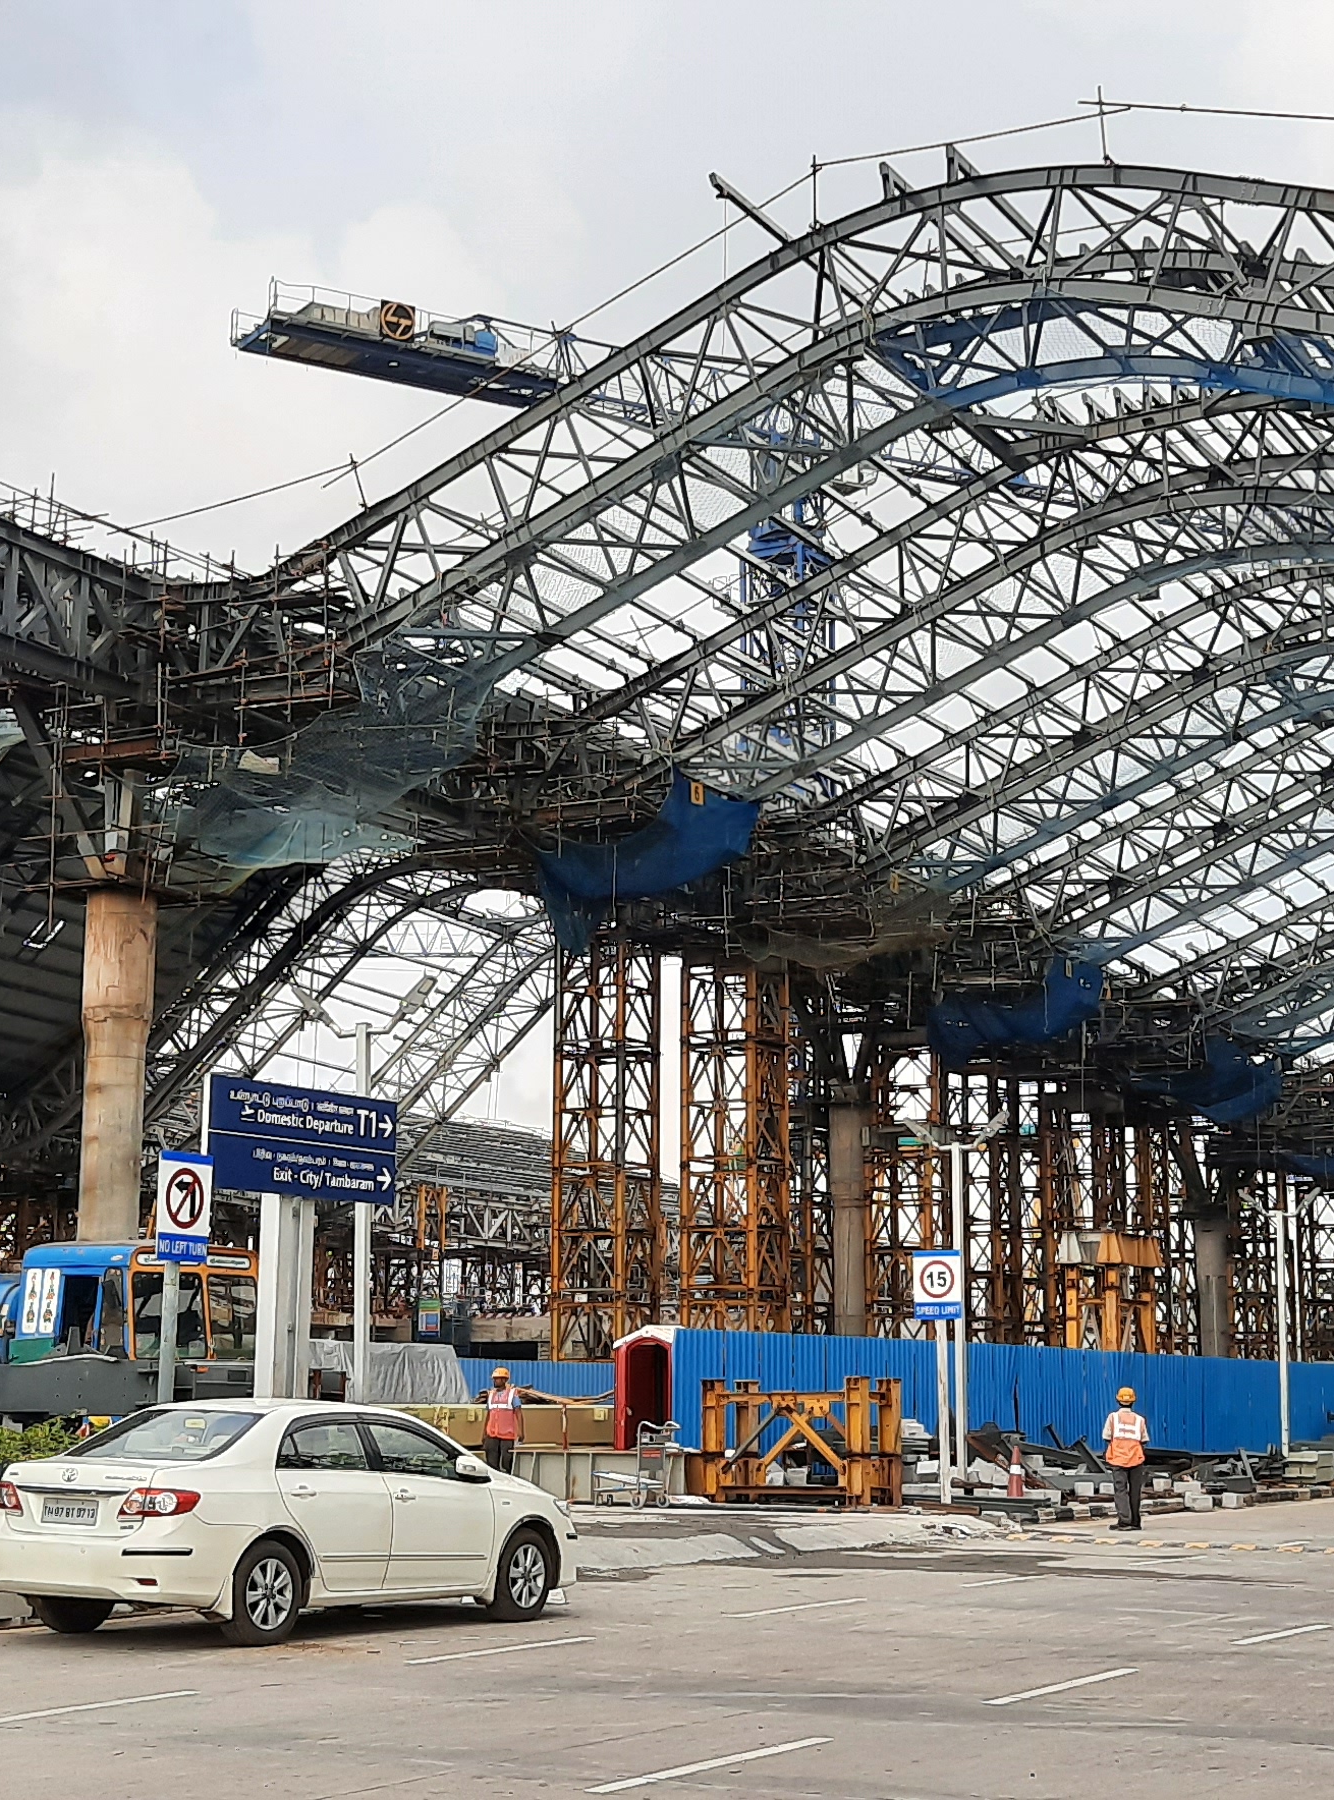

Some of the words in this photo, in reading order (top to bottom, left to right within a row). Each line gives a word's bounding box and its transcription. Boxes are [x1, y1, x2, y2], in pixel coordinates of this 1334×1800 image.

[257, 1109, 304, 1128] Domestic
[306, 1116, 354, 1135] Departure
[357, 1109, 377, 1138] T1
[273, 1167, 293, 1183] Exit
[325, 1173, 375, 1191] Tambaram
[159, 1239, 170, 1253] NO
[171, 1241, 187, 1255] LEFT
[188, 1243, 207, 1257] TURN
[927, 1271, 947, 1288] 15
[916, 1305, 939, 1315] SPEED
[941, 1304, 960, 1315] LIMIT
